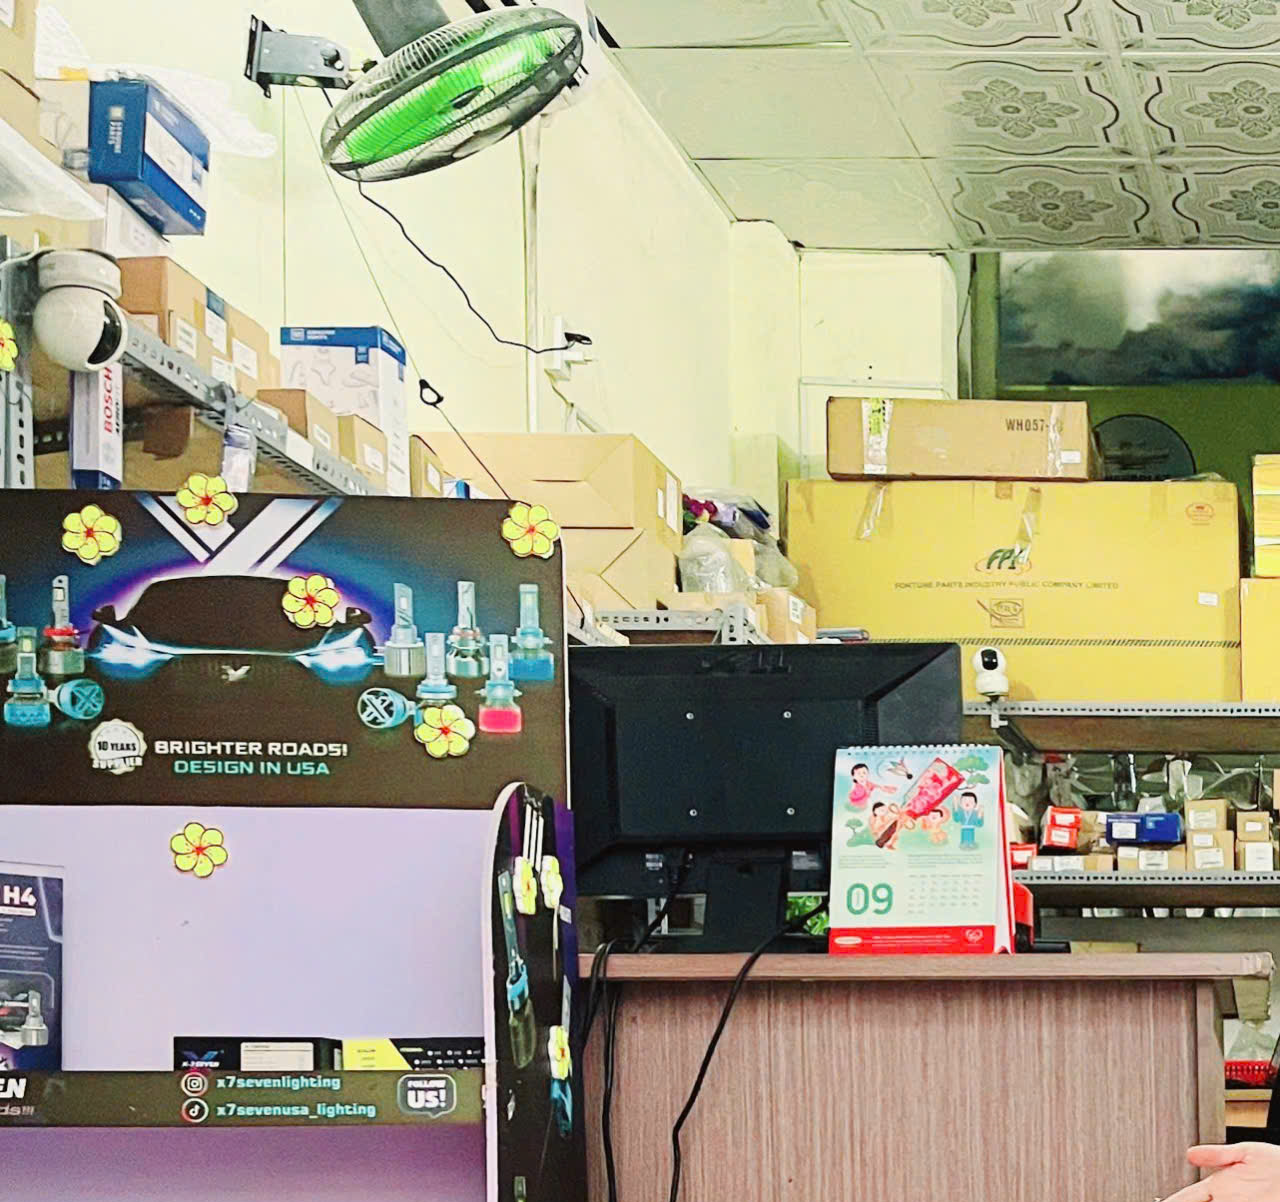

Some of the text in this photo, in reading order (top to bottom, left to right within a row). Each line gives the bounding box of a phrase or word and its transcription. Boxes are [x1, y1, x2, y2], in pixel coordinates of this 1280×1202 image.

[104, 366, 113, 434] BOSCH
[1041, 581, 1083, 589] COMPANY
[1086, 582, 1119, 590] LIMITED
[97, 741, 137, 752] 10 YEARS
[154, 740, 348, 757] BRIGHTER ROADS!
[174, 760, 330, 775] DESIGN IN USA
[3, 885, 37, 906] H4
[846, 883, 894, 915] 09
[216, 1075, 341, 1090] x7sevenlighting
[407, 1079, 447, 1089] FOLLOW
[407, 1089, 446, 1108] US!
[216, 1103, 376, 1118] x7sevenusa_lighting
